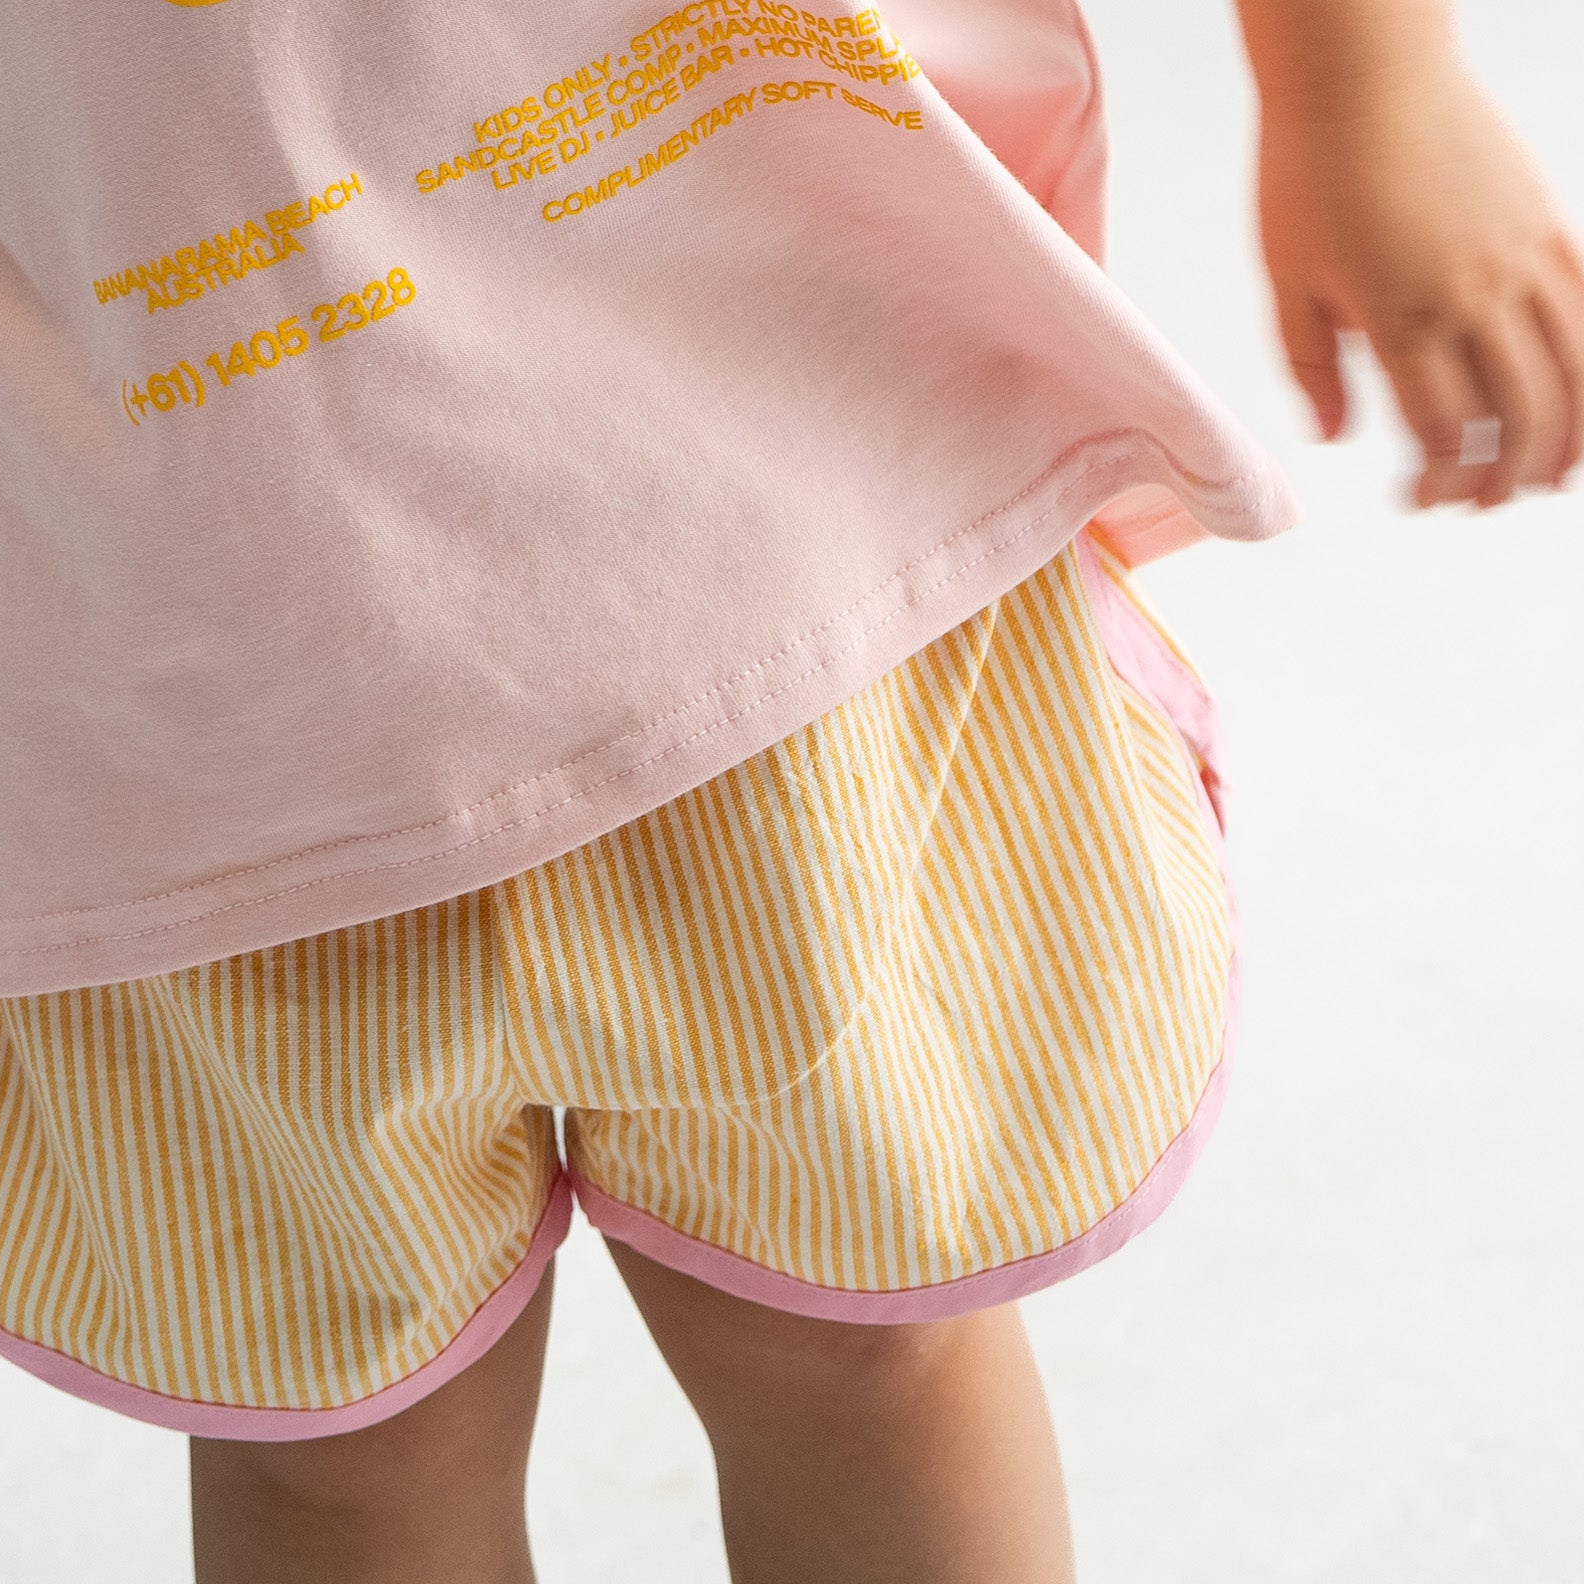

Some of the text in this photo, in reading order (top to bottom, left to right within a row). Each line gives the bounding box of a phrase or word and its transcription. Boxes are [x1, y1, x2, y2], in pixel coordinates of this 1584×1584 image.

[415, 92, 606, 194] SANDCASTLE
[607, 44, 681, 106] COMP
[697, 17, 833, 54] MAXIMUM
[474, 96, 543, 144] KIDS
[544, 53, 611, 109] ONLY
[491, 148, 558, 191] LIVE
[559, 131, 591, 163] DJ
[611, 78, 681, 138] JUICE
[680, 45, 735, 91] BAR
[755, 37, 814, 58] HOT
[542, 80, 924, 222] COMPLIMENTARY SOFT SERVE
[93, 172, 363, 305] BANANARAMA BEACH
[147, 233, 305, 315] AUSTRALIA
[122, 266, 416, 426] (+61) 1405 2328
